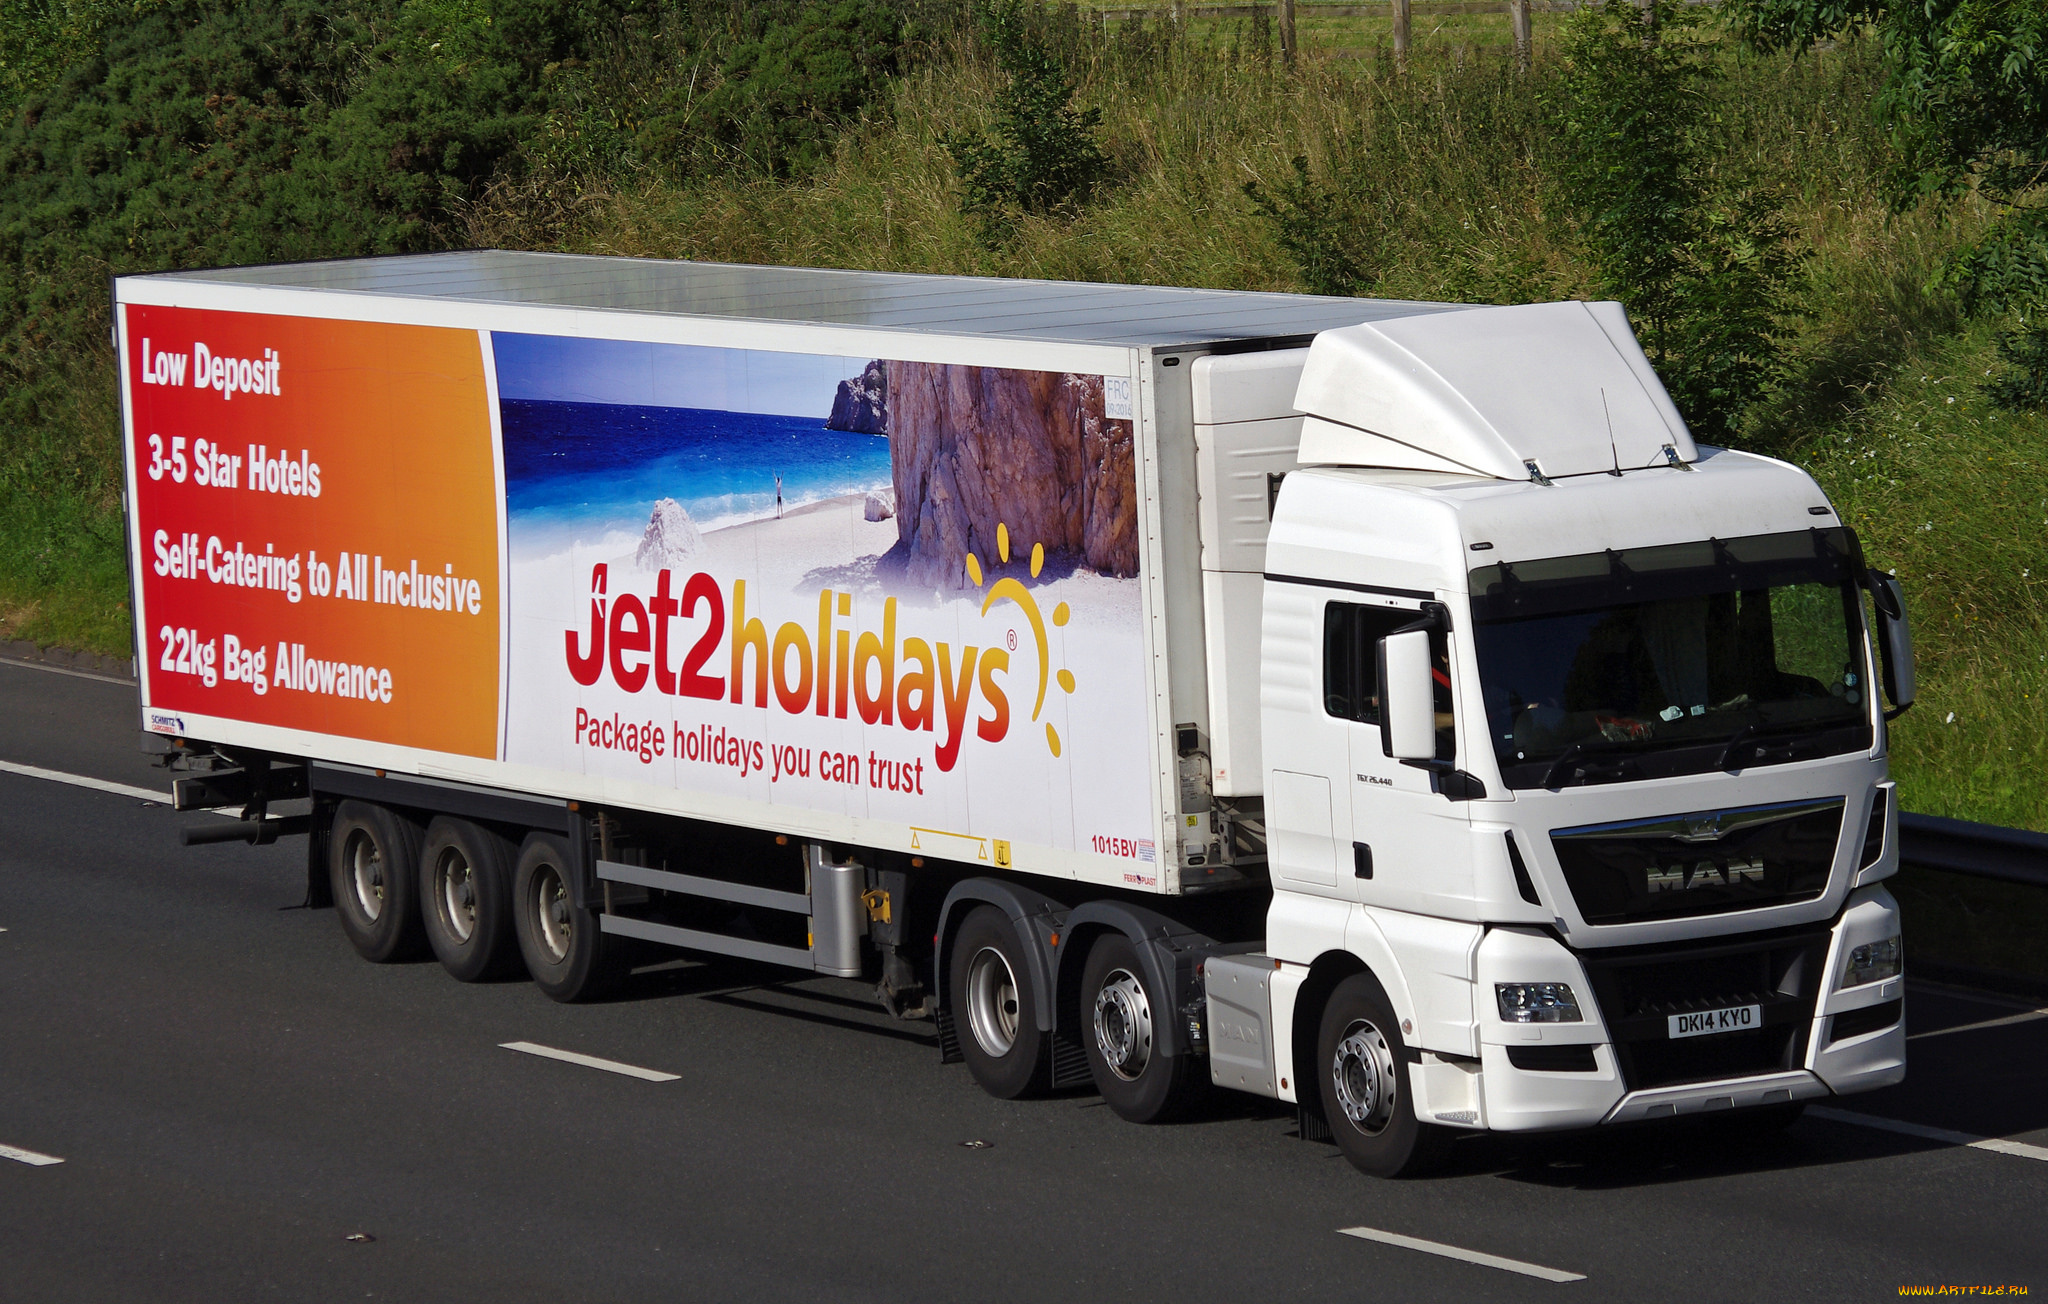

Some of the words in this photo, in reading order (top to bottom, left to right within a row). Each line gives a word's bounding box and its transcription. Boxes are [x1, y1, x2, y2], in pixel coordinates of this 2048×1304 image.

[142, 337, 188, 386] Low
[194, 342, 281, 400] Deposit
[1107, 379, 1129, 400] FRC
[148, 433, 187, 483] 3-5
[194, 438, 242, 488] Star
[248, 444, 321, 498] Hotels
[153, 529, 301, 603] Self-Catering
[307, 550, 331, 597] to
[335, 552, 368, 601] All
[374, 556, 481, 615] Inclusive
[159, 625, 218, 688] 22kg
[223, 634, 268, 695] Bag
[273, 641, 393, 704] Allowance
[575, 707, 665, 764] Package
[673, 719, 764, 778] holidays
[771, 744, 810, 783] you
[819, 751, 860, 785] can
[868, 751, 924, 796] trust
[1091, 834, 1137, 859] 1015BV
[1646, 857, 1764, 893] MAN
[1678, 1012, 1715, 1033] DK14
[1719, 1007, 1751, 1028] KYO
